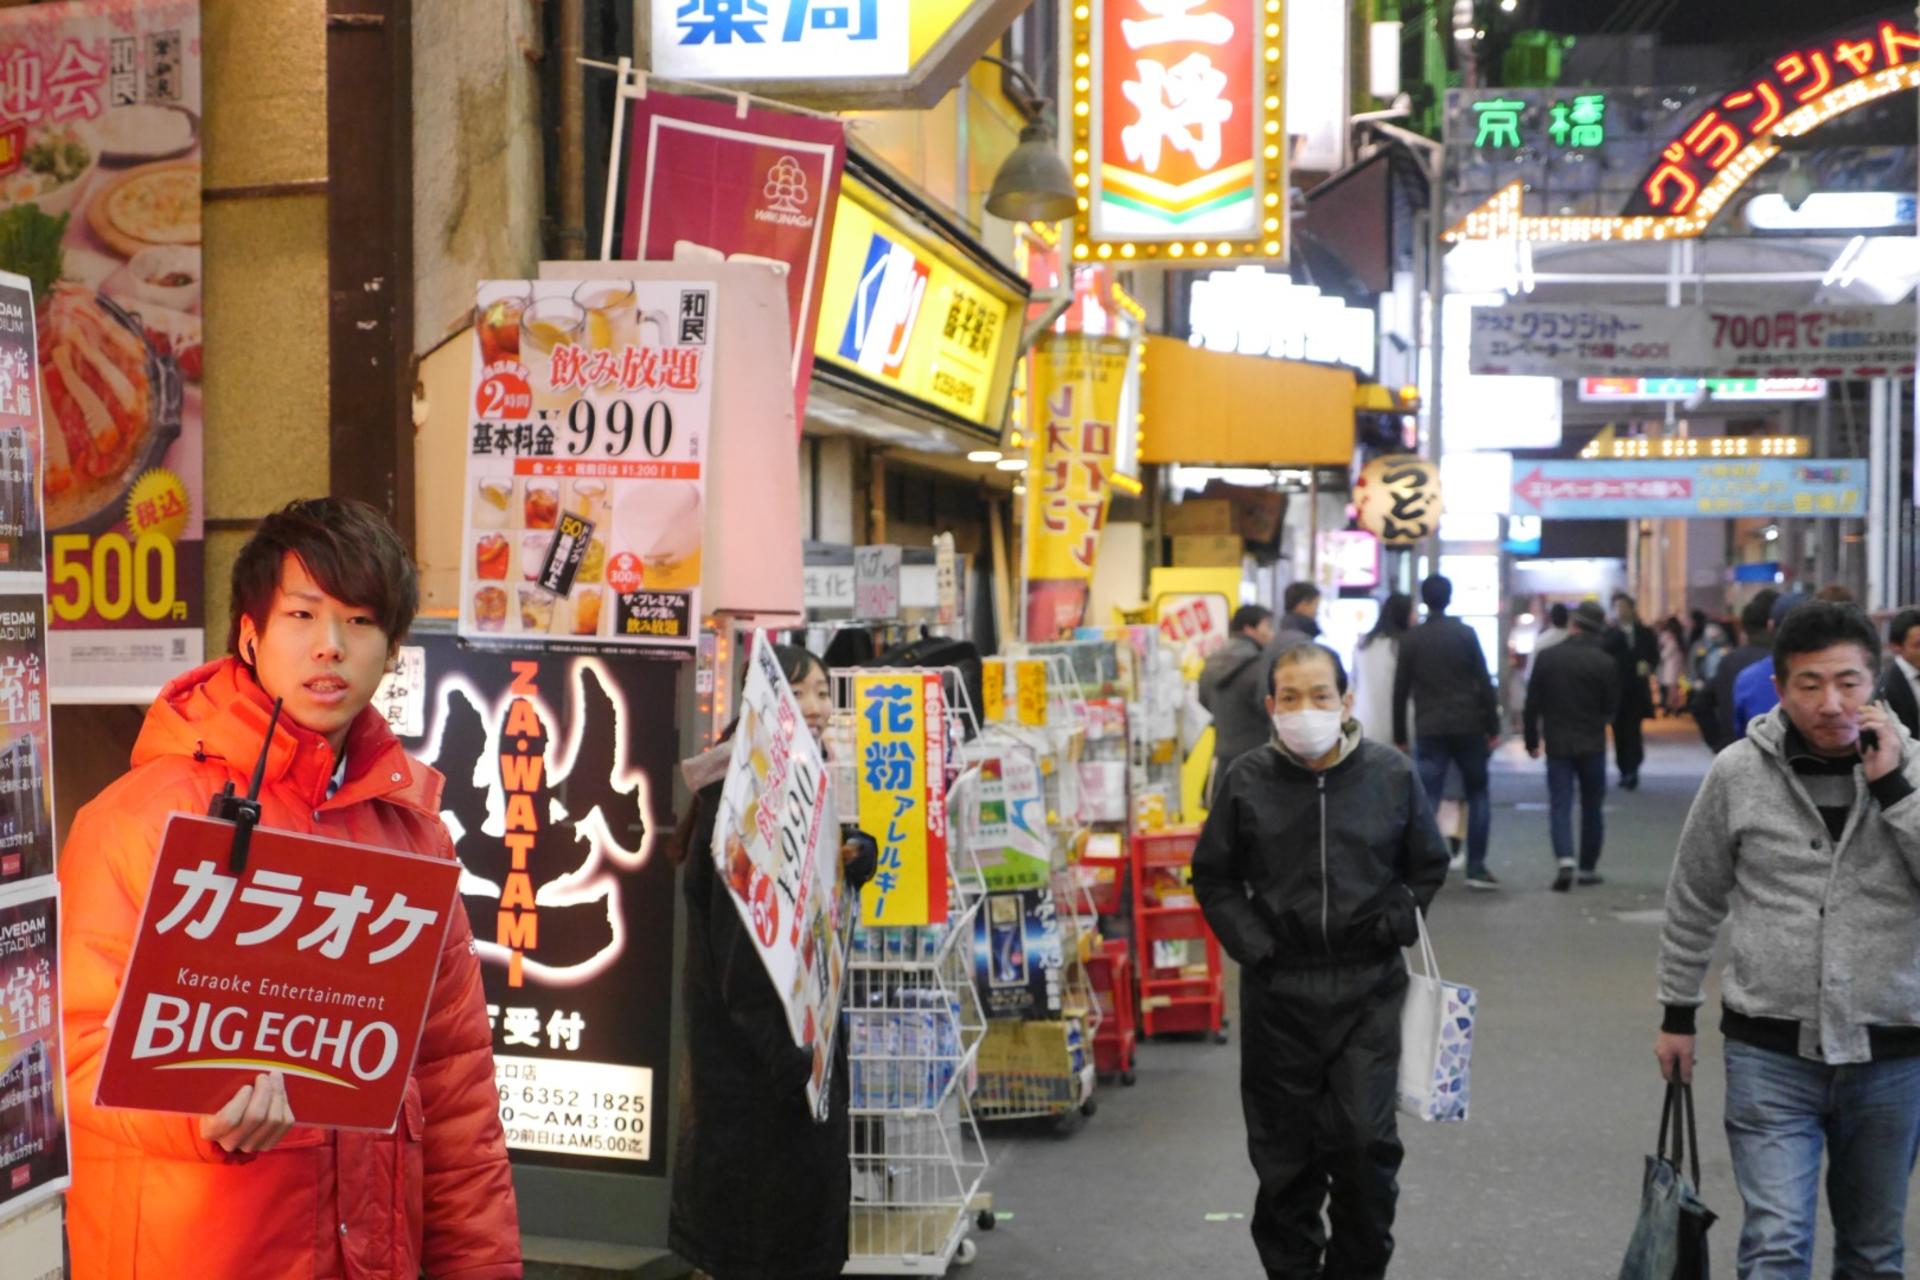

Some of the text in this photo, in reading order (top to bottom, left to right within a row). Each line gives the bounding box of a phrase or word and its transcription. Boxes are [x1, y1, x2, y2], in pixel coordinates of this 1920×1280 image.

[1472, 95, 1605, 148] 京橋
[683, 292, 706, 343] 和民
[1710, 312, 1825, 349] 700円で
[550, 346, 700, 392] 飲み放題
[472, 422, 554, 456] 基本料金
[155, 860, 438, 964] カラオケ
[177, 967, 385, 1011] Karaoke Entertainment
[131, 993, 399, 1081] BIG ECHO
[592, 1093, 645, 1114] 1825
